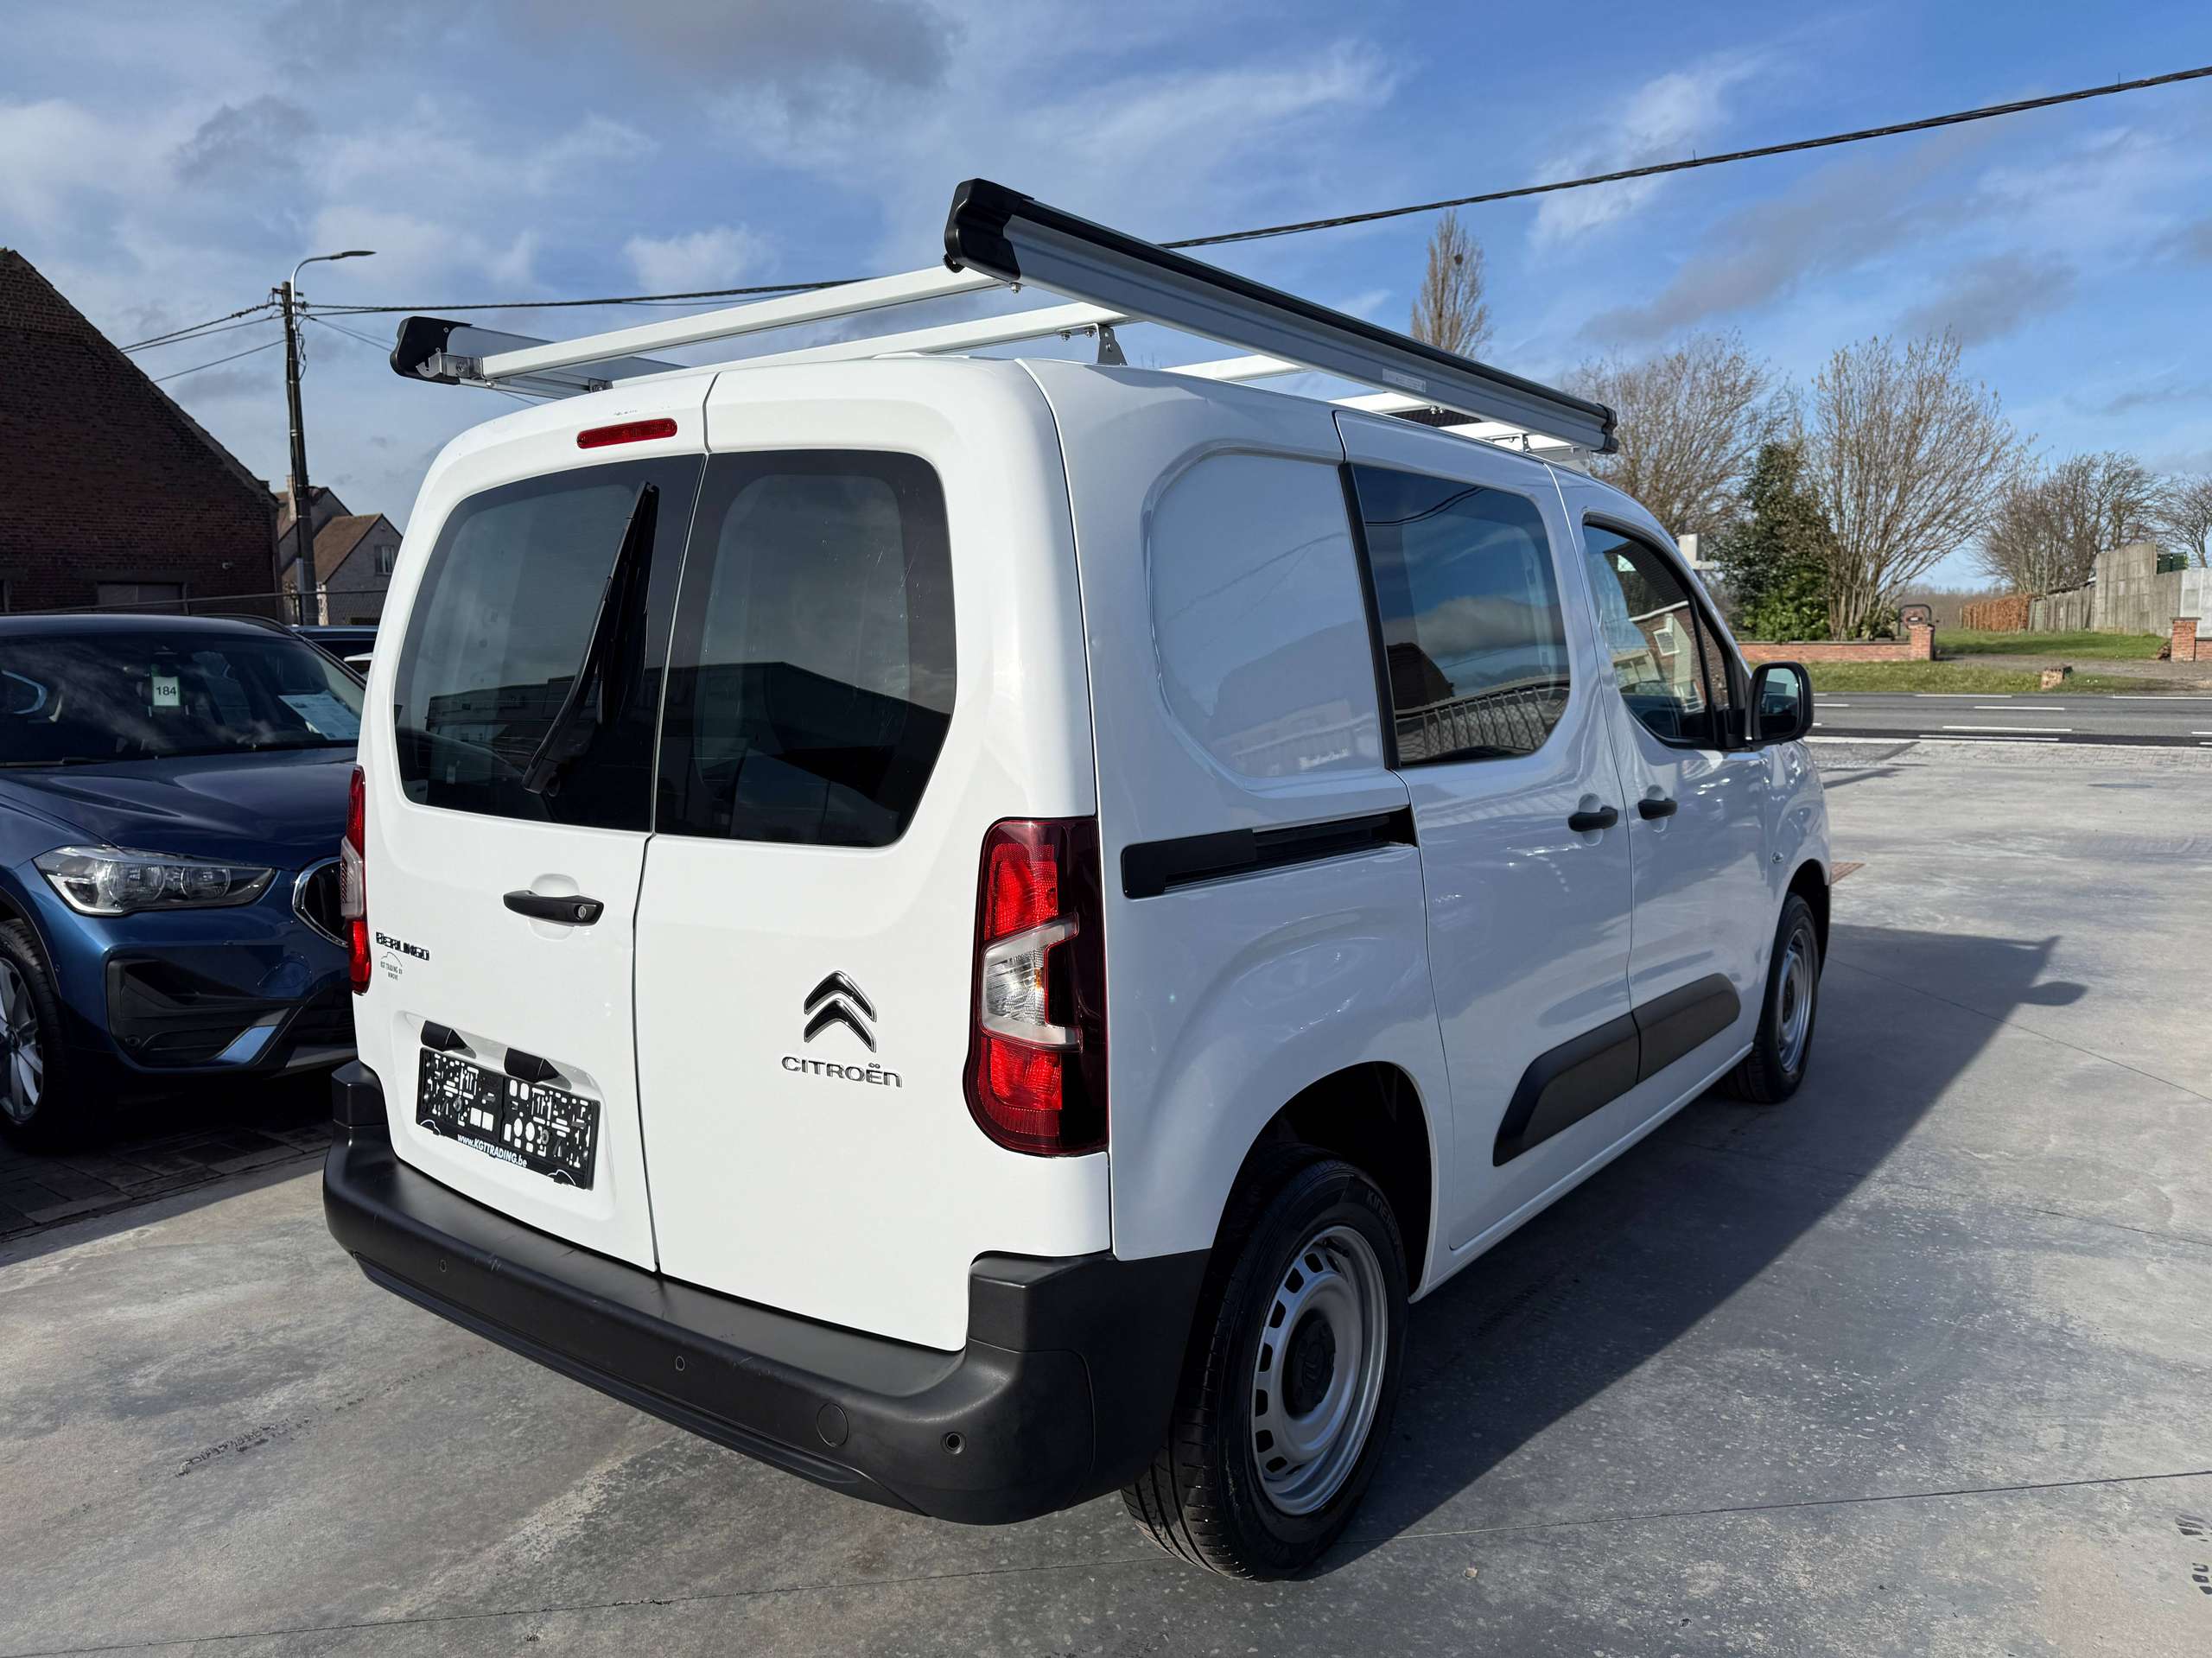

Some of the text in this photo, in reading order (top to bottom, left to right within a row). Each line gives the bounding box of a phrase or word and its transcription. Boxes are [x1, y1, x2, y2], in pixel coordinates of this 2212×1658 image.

[156, 686, 176, 696] 184
[375, 931, 429, 961] BERLINGO
[781, 1056, 903, 1088] CITROËN
[457, 1134, 528, 1168] www.KGTTRADING.be
